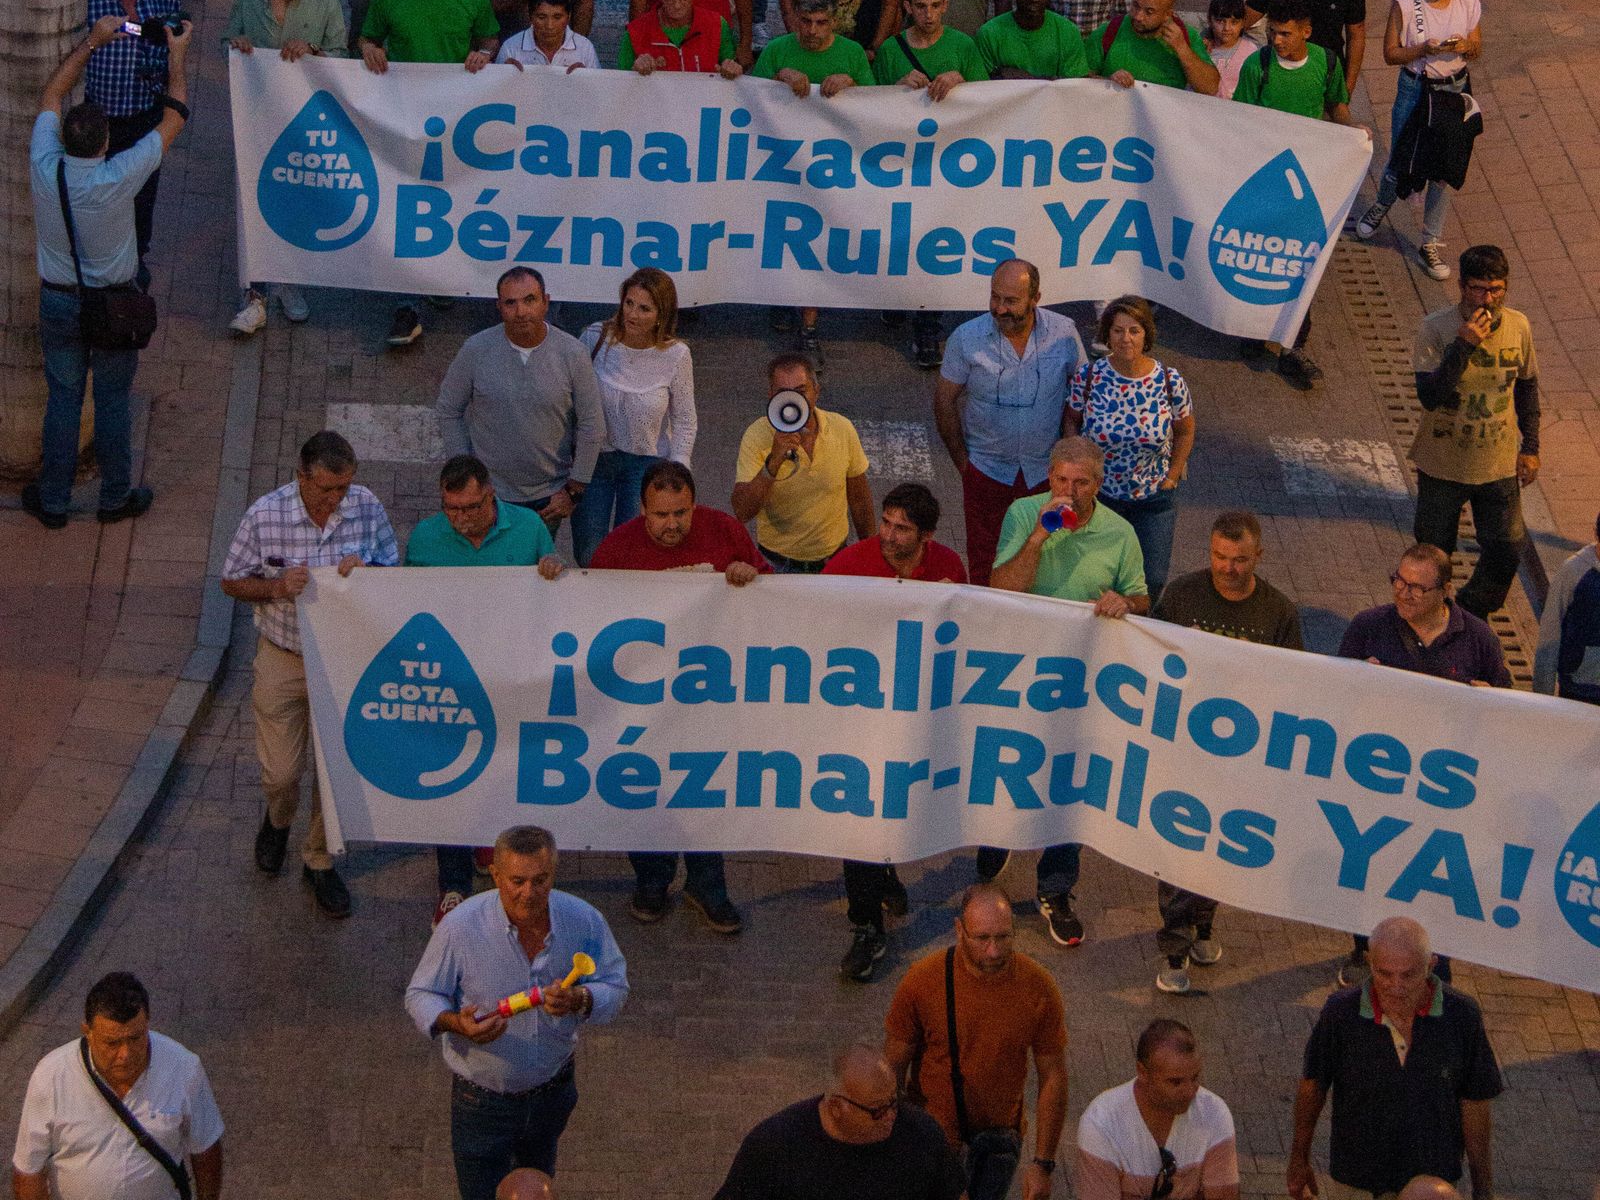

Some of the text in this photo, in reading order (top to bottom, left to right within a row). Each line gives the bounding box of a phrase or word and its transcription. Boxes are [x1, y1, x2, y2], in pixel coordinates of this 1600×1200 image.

[306, 129, 337, 147] TU
[420, 102, 1156, 189] ¡Canalizaciones
[287, 152, 351, 170] GOTA
[272, 166, 364, 190] CUENTA
[395, 188, 1194, 281] Béznar-Rules YA!
[1213, 224, 1321, 258] ¡AHORA
[1217, 247, 1313, 278] RULES!
[400, 660, 442, 679] TU
[380, 682, 460, 705] GOTA
[361, 701, 477, 725] CUENTA
[549, 618, 1480, 810] ¡Canalizaciones
[517, 722, 1534, 930] Béznar-Rules YA!
